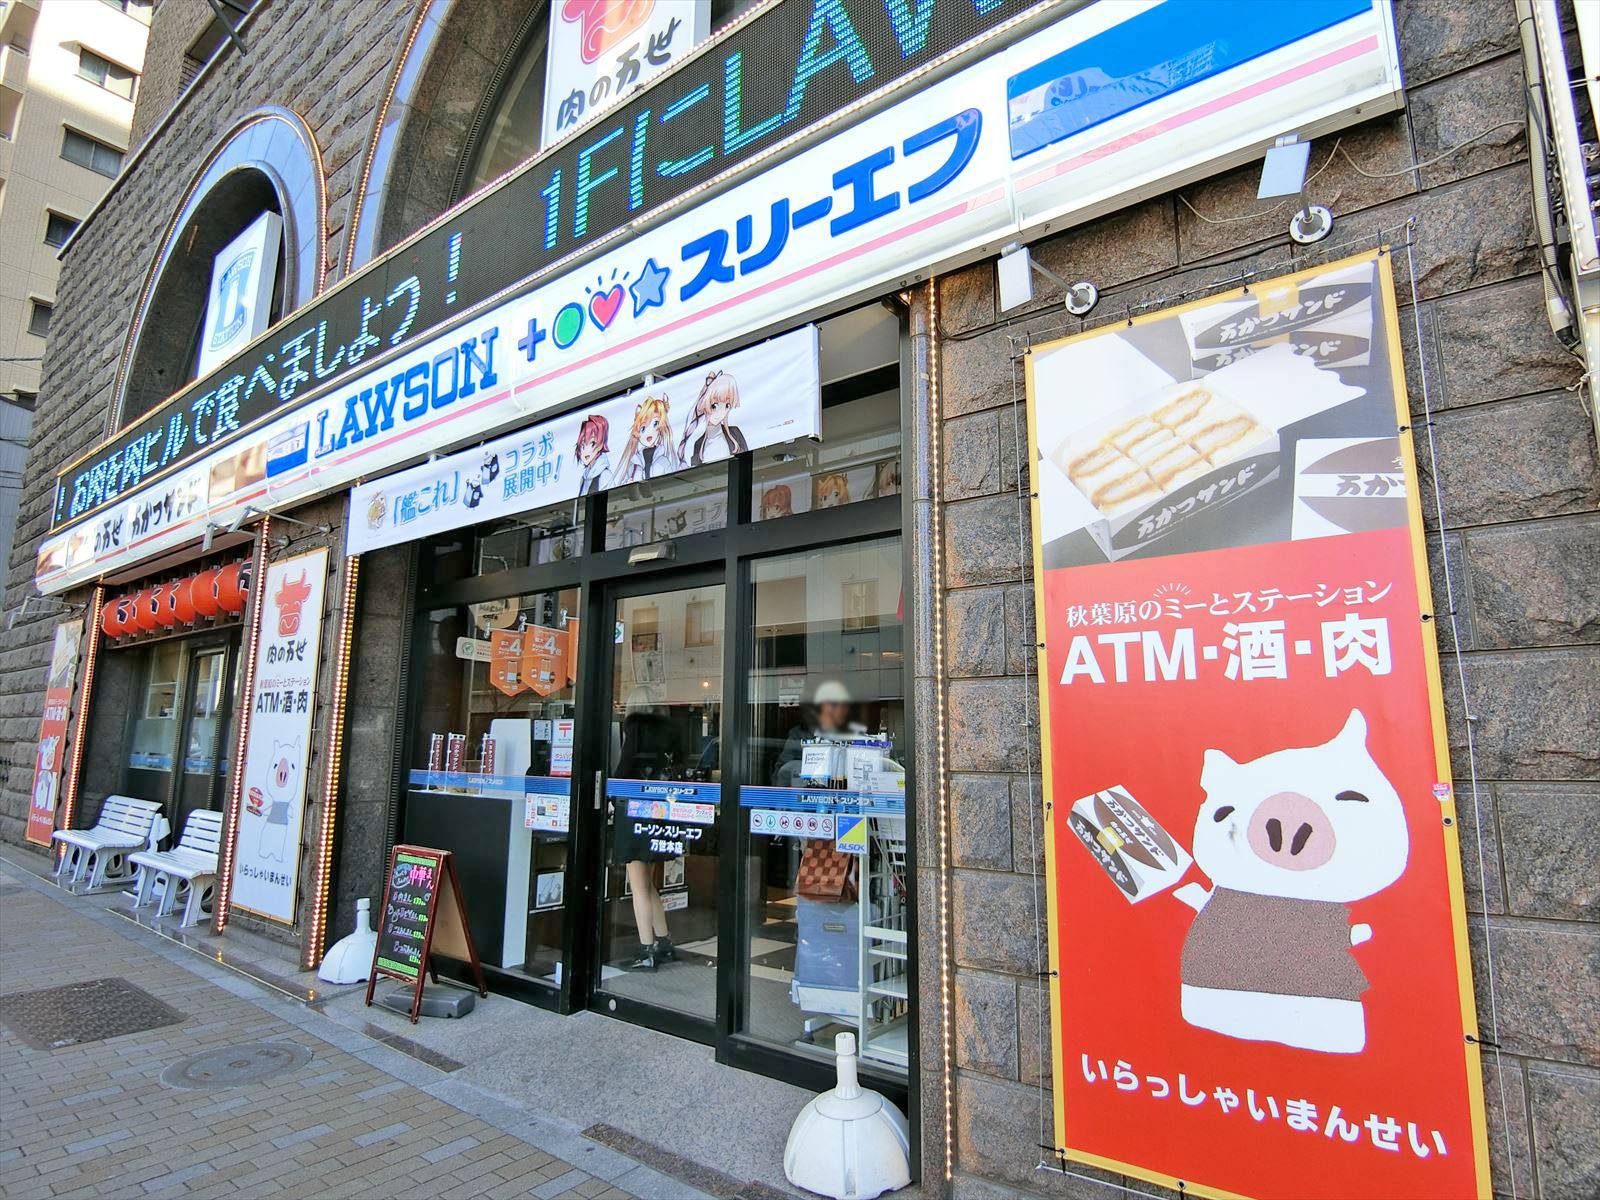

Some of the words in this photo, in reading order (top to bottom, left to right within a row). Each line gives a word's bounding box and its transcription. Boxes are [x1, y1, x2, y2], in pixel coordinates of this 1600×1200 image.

[556, 16, 680, 131] 肉の万世
[314, 326, 499, 459] LAWSON
[680, 107, 983, 301] スリーエフ
[1138, 463, 1257, 540] 万かつサンド
[1066, 580, 1393, 628] 秋葉原のミーとステーション
[267, 638, 308, 664] 肉の万世
[1059, 613, 1393, 686] ATM・酒・肉
[634, 823, 703, 840] ローソン・スリーエフ
[650, 839, 683, 855] 万世本店
[838, 843, 865, 852] ALSOK
[1106, 799, 1165, 857] 万かつサンド
[1081, 1053, 1449, 1159] いらっしゃいまんせい
